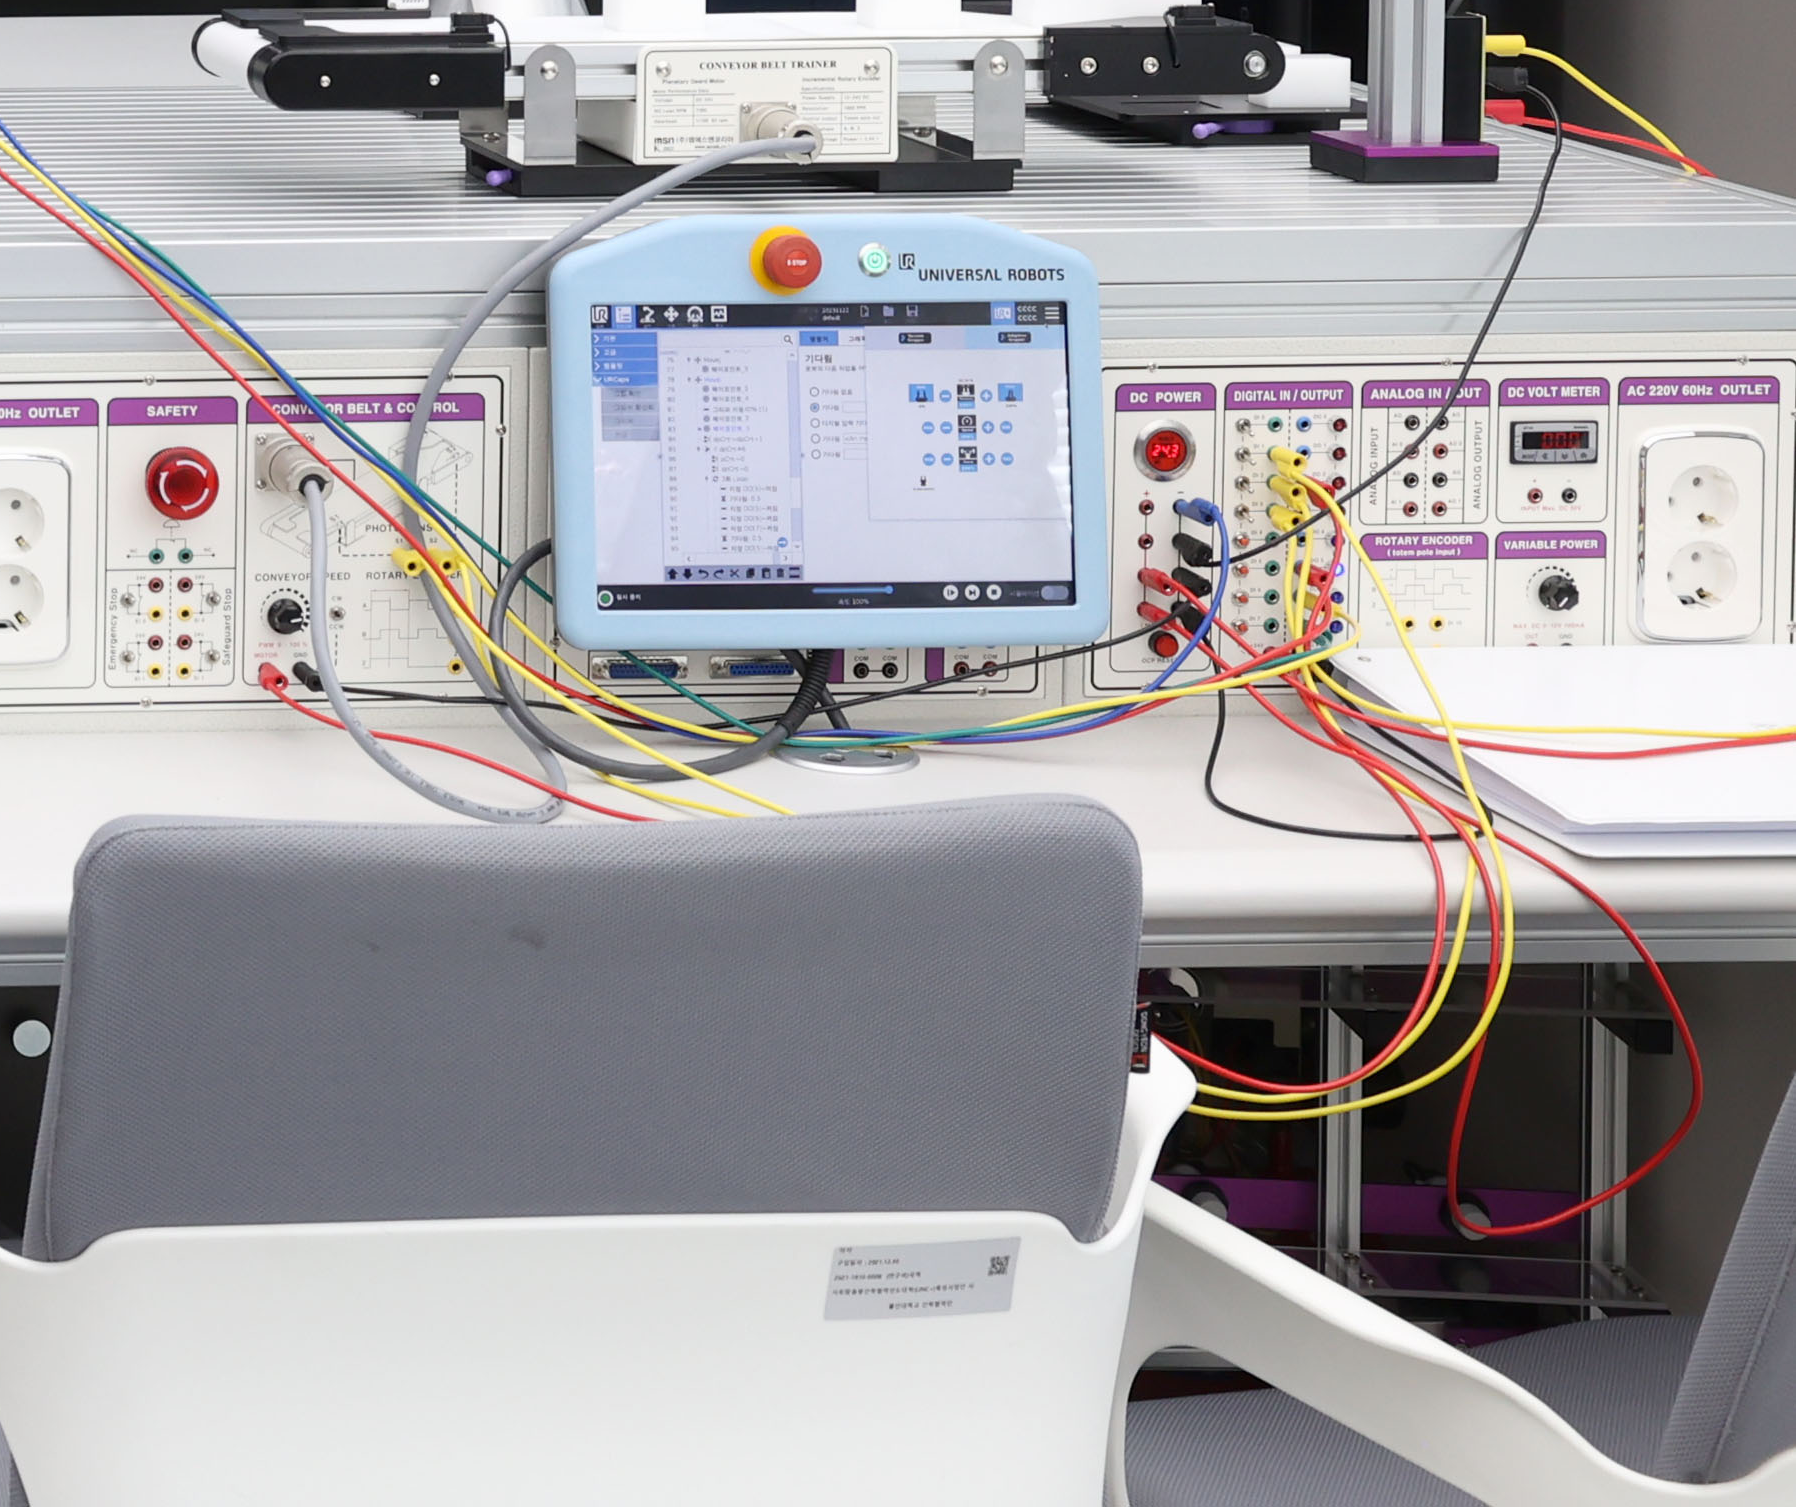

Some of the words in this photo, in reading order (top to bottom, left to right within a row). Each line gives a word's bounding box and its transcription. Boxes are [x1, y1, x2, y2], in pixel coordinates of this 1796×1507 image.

[699, 61, 757, 70] CONVEYOR
[761, 61, 786, 69] BELT
[791, 60, 837, 69] TRAINER
[919, 268, 1001, 281] UNIVERSAL
[1008, 268, 1065, 281] ROBOTS
[1234, 390, 1277, 401] DIGITAL
[1280, 390, 1292, 401] IN
[1301, 389, 1344, 401] OUTPUT
[1370, 388, 1425, 399] ANALOG
[1427, 388, 1441, 398] IN
[1454, 387, 1482, 398] OUT
[1507, 387, 1525, 397] DC
[1527, 387, 1558, 397] VOLT
[1560, 386, 1601, 397] METER
[1627, 385, 1646, 396] AC
[1649, 385, 1679, 396] 220V
[1682, 384, 1714, 396] 60Hz
[1720, 384, 1771, 395] OUTLET
[1130, 392, 1148, 403] DC
[1155, 391, 1202, 403] POWER
[28, 407, 80, 418] OUTLET
[147, 405, 198, 417] SAFETY
[347, 403, 381, 414] BELT
[384, 403, 393, 414] &
[397, 401, 460, 413] COROL
[1370, 427, 1379, 458] INPUT
[1474, 420, 1483, 462] OUTPUT
[1473, 464, 1482, 509] ANALOG
[365, 524, 400, 532] PHOT
[1375, 536, 1419, 545] ROTARY
[1422, 535, 1473, 545] ENCODER
[1504, 540, 1558, 550] VARIABLE
[1560, 539, 1599, 549] POWER
[327, 572, 351, 581] PEED
[366, 571, 408, 580] ROTARY
[110, 588, 118, 612] Stop
[223, 588, 232, 611] Stop
[109, 614, 118, 670] Emergency
[222, 614, 232, 666] Safeguard
